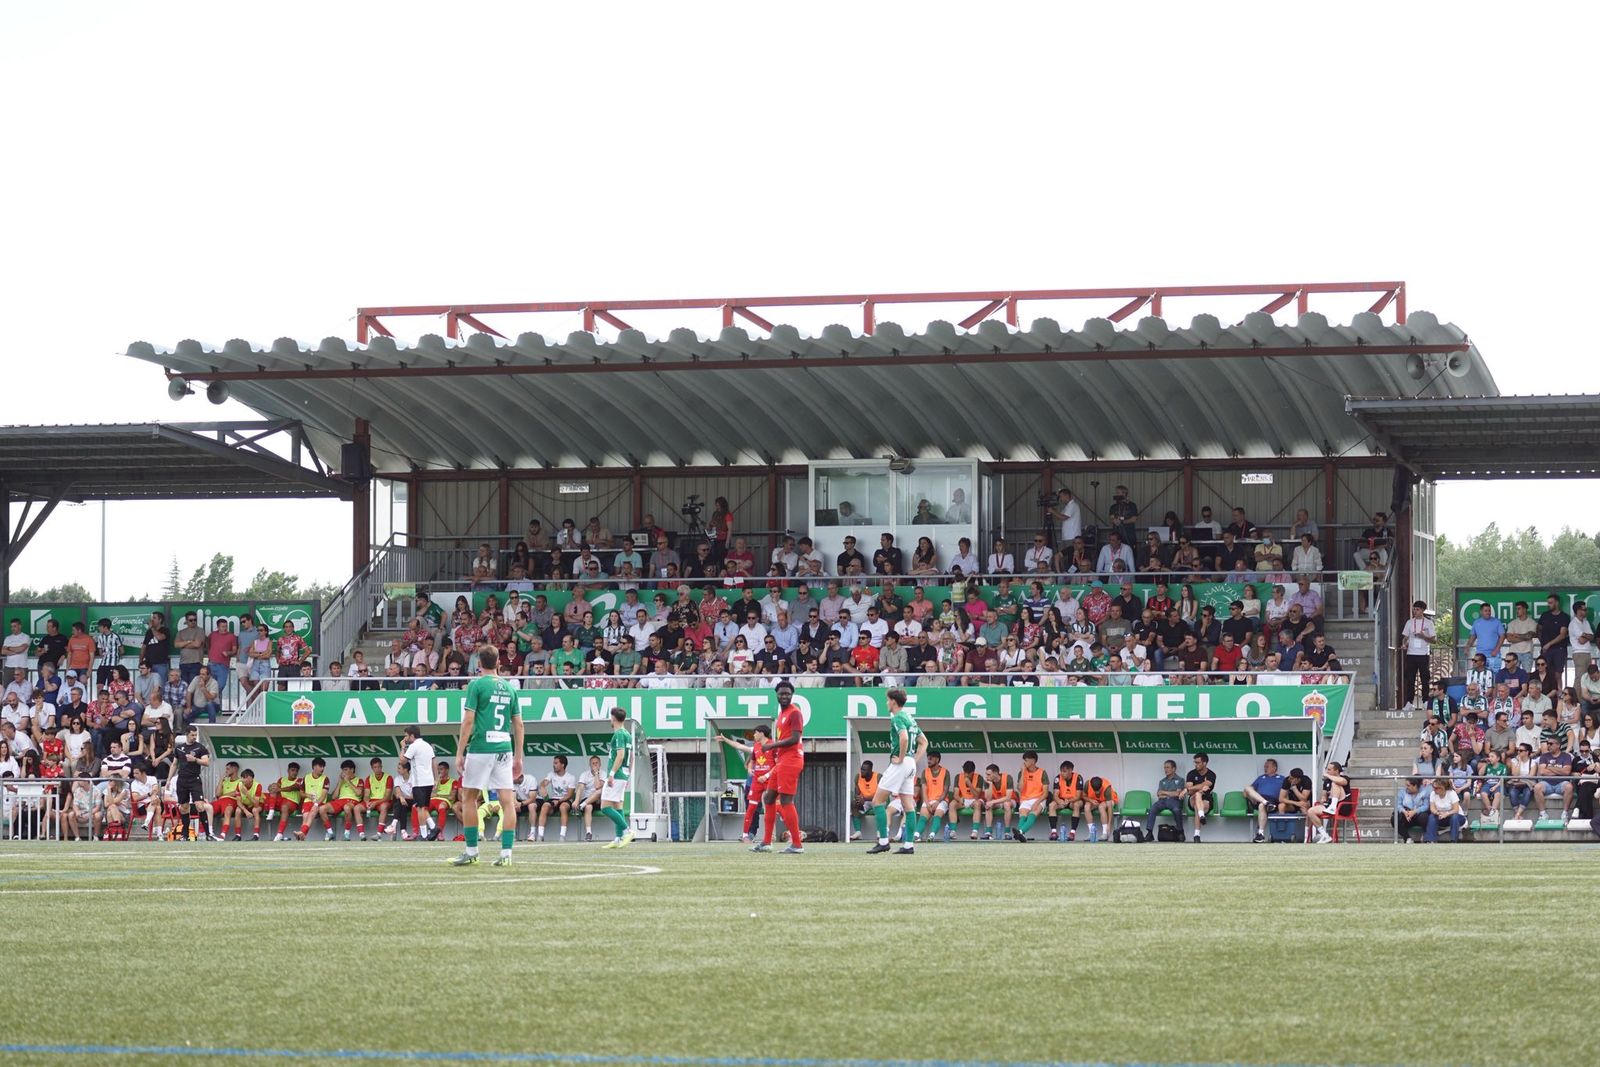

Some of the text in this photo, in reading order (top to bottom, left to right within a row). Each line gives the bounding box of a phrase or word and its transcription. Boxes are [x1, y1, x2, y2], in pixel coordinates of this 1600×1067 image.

[1338, 658, 1354, 666] ILA
[339, 695, 812, 730] AYUAMIENT
[953, 693, 1271, 719] GUIJUELO
[1386, 711, 1414, 719] FILA 5
[494, 704, 506, 731] 5
[930, 741, 974, 749] LA GACETA
[993, 741, 1038, 749] LA GACETA
[1059, 741, 1104, 749] LA GACETA
[1126, 741, 1171, 749] LA GACETA
[1193, 741, 1238, 749] LA GACETA
[1262, 741, 1308, 749] LA GACETA
[1377, 739, 1405, 748] FILA 4
[1370, 768, 1398, 776] FILA 3
[1385, 798, 1391, 806] 2
[1375, 829, 1380, 837] 1
